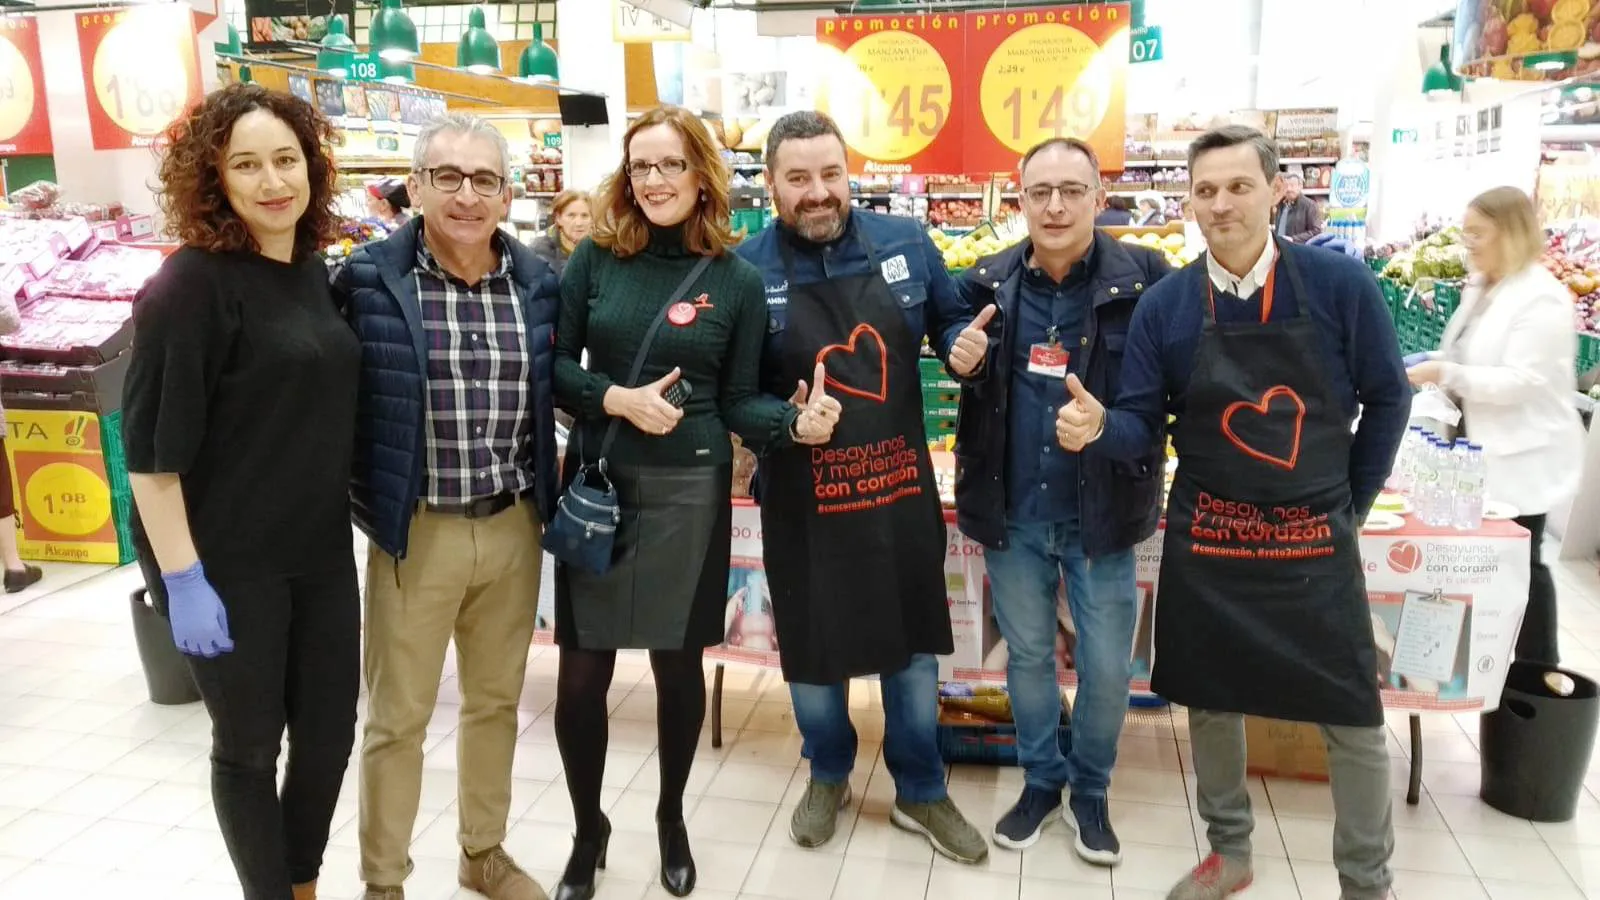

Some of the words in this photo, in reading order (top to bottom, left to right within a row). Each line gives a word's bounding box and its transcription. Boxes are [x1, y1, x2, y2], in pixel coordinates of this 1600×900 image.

[824, 14, 959, 36] promoción
[976, 5, 1118, 31] promoción
[350, 62, 377, 79] 108
[863, 159, 912, 174] Alcampo
[811, 434, 906, 465] Desayunos
[815, 482, 851, 499] con
[1199, 492, 1310, 519] Desaynos
